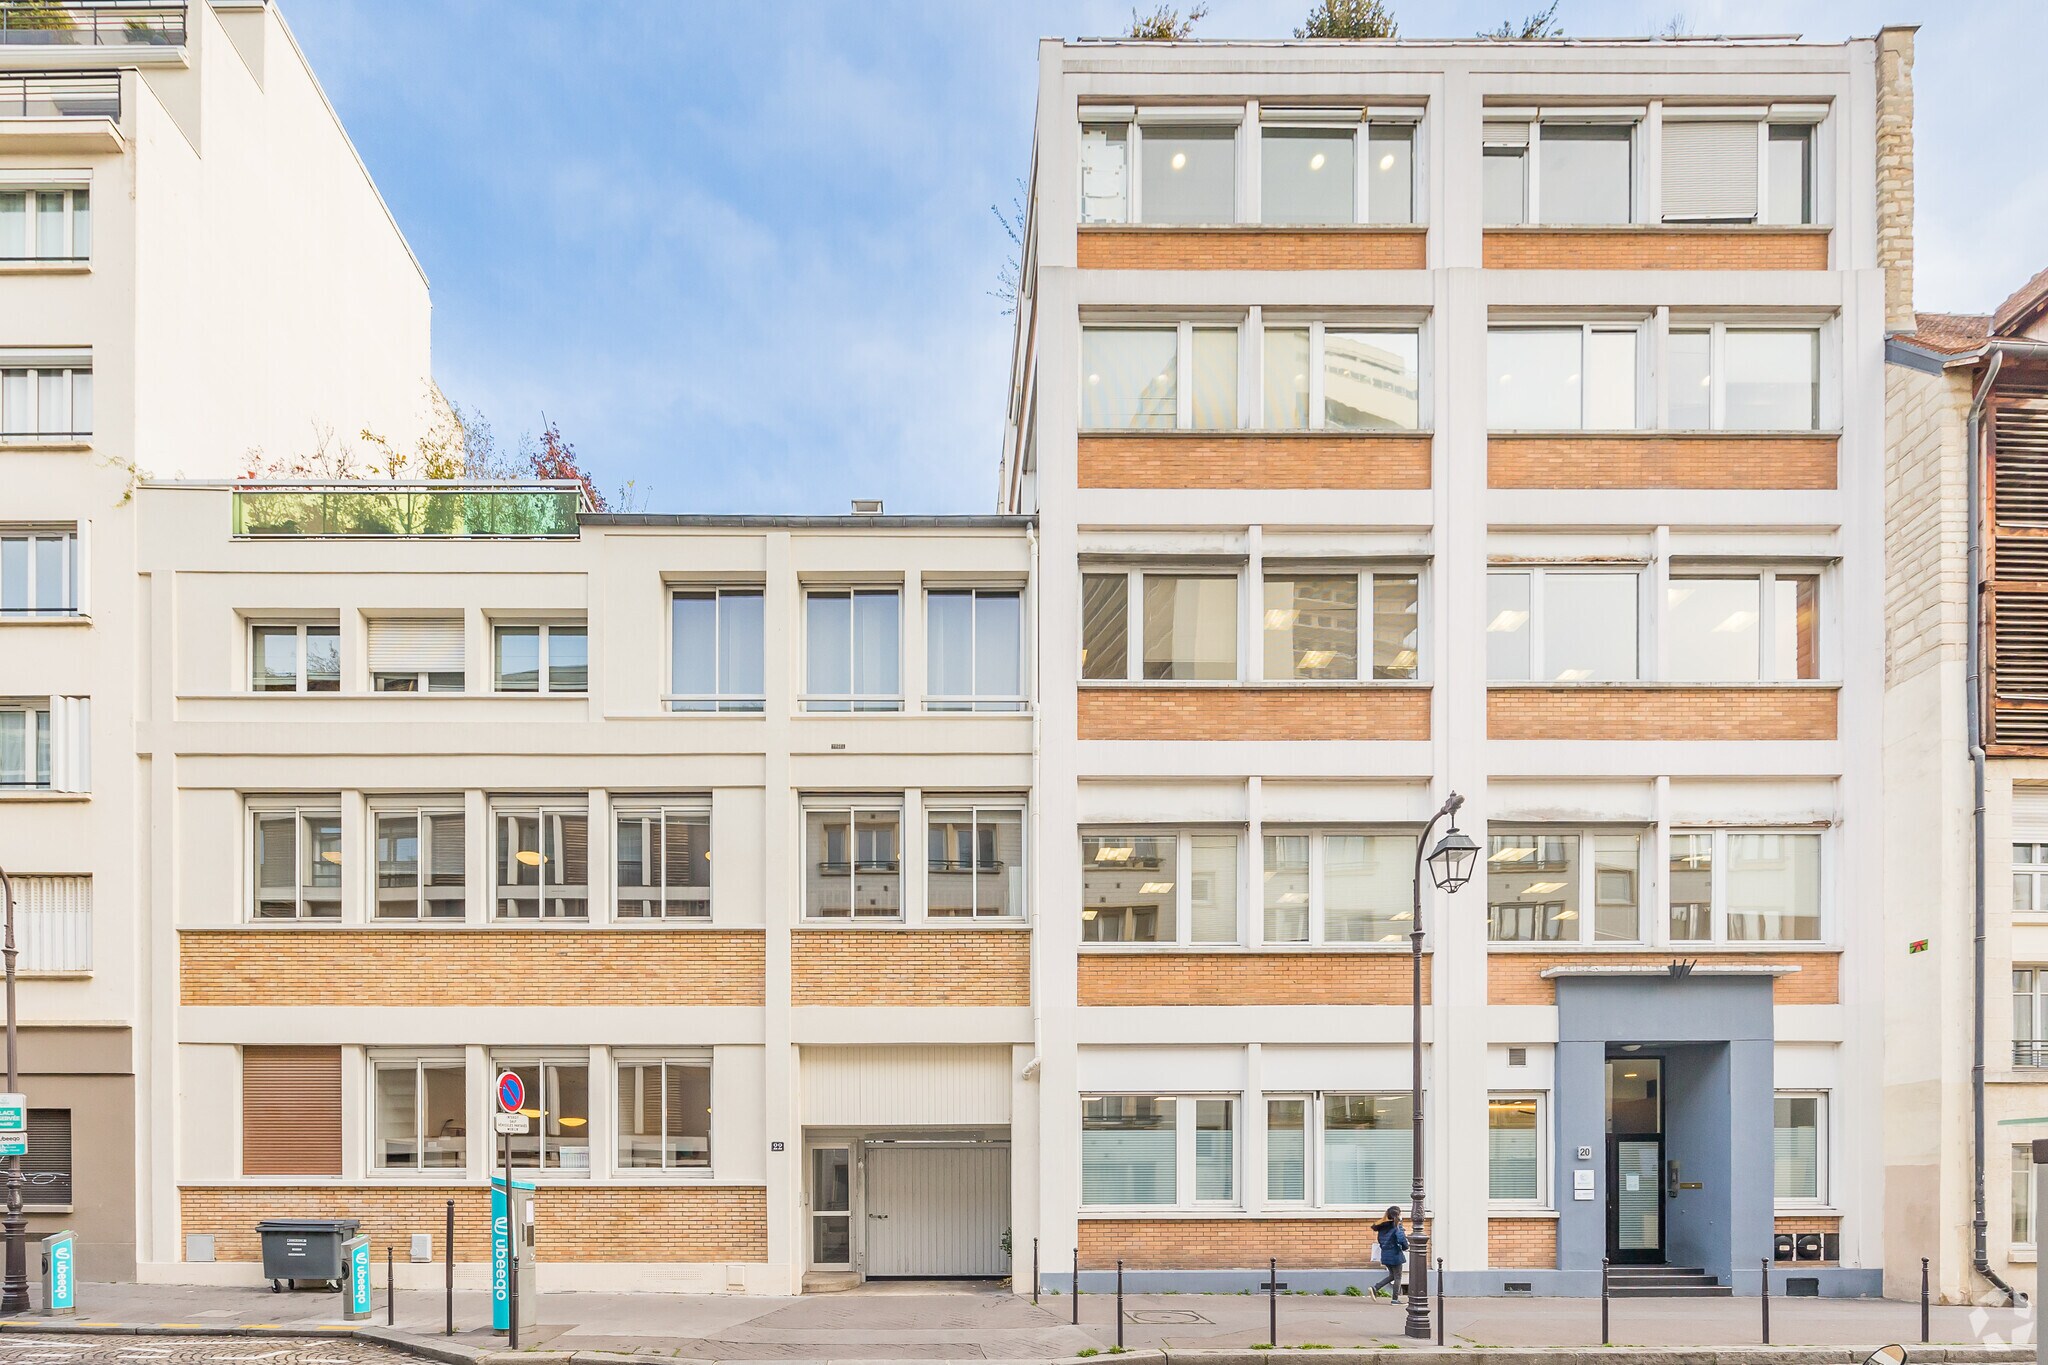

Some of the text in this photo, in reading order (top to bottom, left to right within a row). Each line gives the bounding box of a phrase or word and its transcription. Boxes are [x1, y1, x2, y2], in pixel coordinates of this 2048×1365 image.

[772, 1142, 783, 1150] 22
[1579, 1147, 1590, 1157] 20
[54, 1260, 70, 1299] ubeeqo
[355, 1266, 367, 1304] ubeeqo
[494, 1238, 508, 1301] ubeeqo
